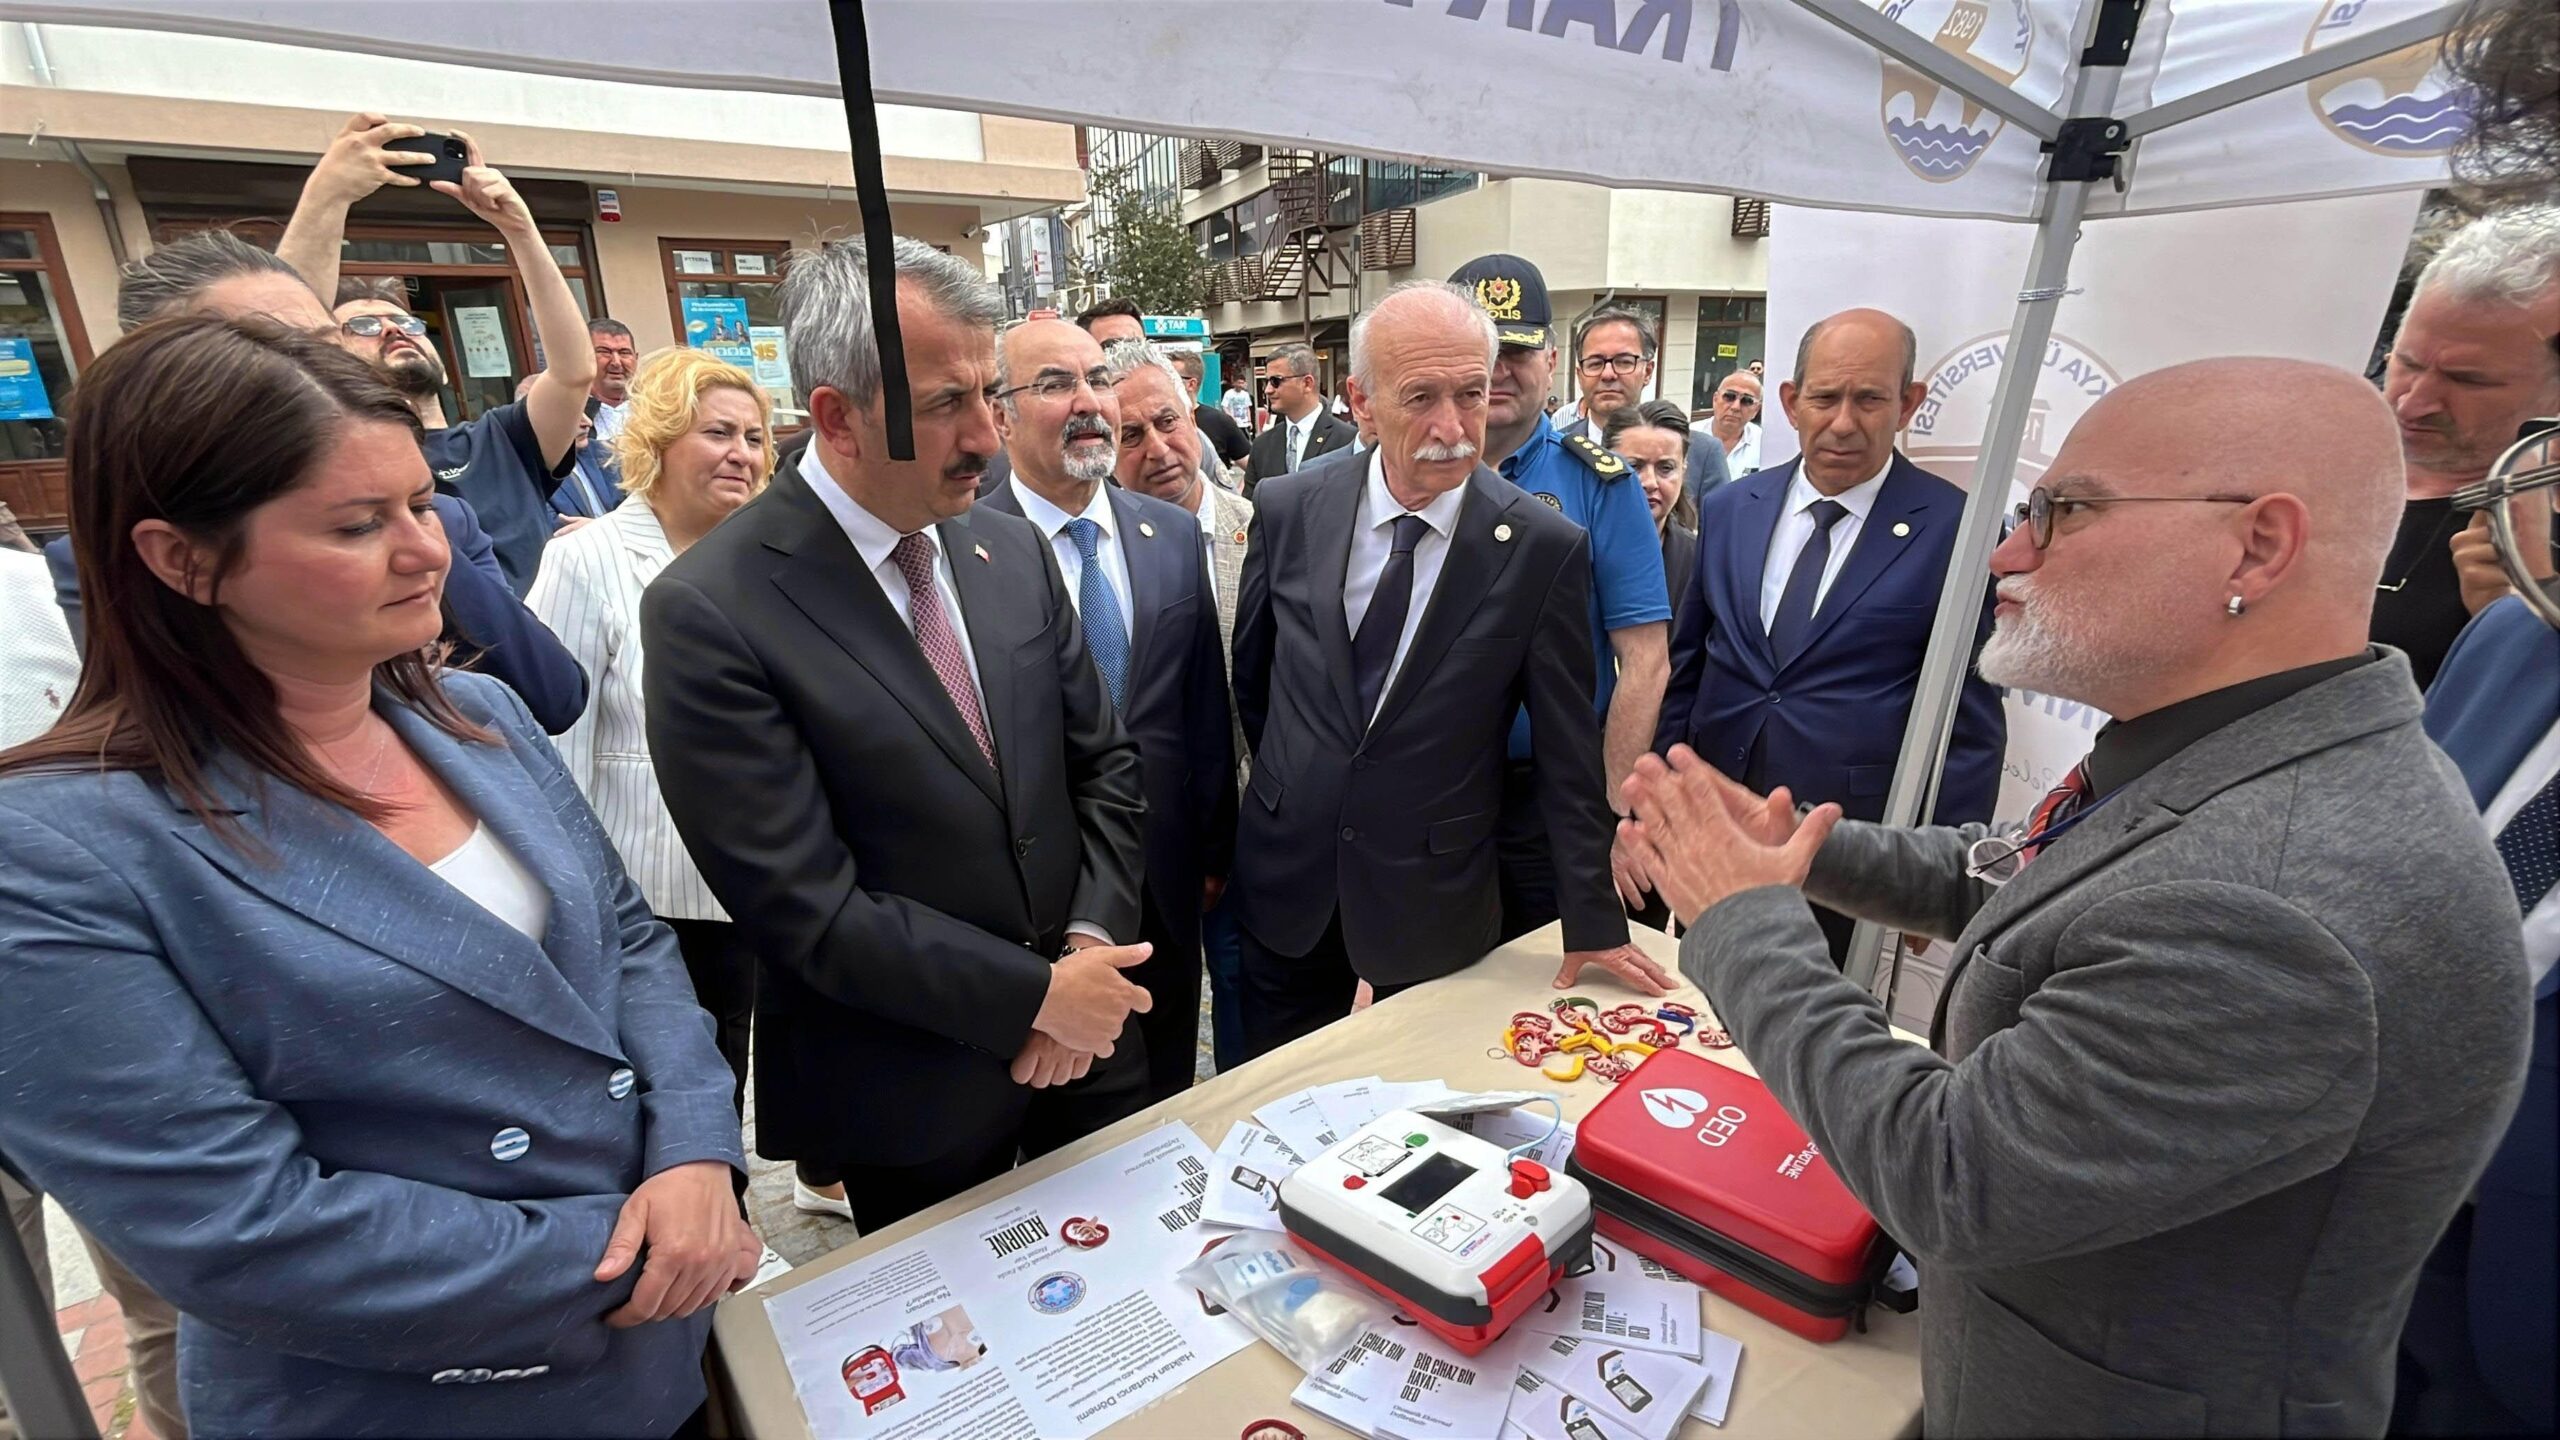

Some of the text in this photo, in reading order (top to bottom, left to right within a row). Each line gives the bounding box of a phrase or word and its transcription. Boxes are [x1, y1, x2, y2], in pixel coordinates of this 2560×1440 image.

[1167, 320, 1187, 330] TAN
[1486, 309, 1521, 320] OLİS
[1697, 1105, 1747, 1147] OED
[1177, 1155, 1204, 1175] OED
[1158, 1209, 1188, 1232] BİN
[985, 1215, 1049, 1259] AEDİRNE
[1605, 1314, 1627, 1336] HAYAT
[1628, 1325, 1650, 1340] OED
[1363, 1331, 1407, 1362] CİHAZ BİN
[1158, 1351, 1195, 1375] Halktan
[1413, 1351, 1476, 1386] BİR CİHAZ BİN
[1407, 1369, 1438, 1391] HAYAT
[1400, 1385, 1421, 1403] OED
[1076, 1396, 1118, 1423] Dönemi
